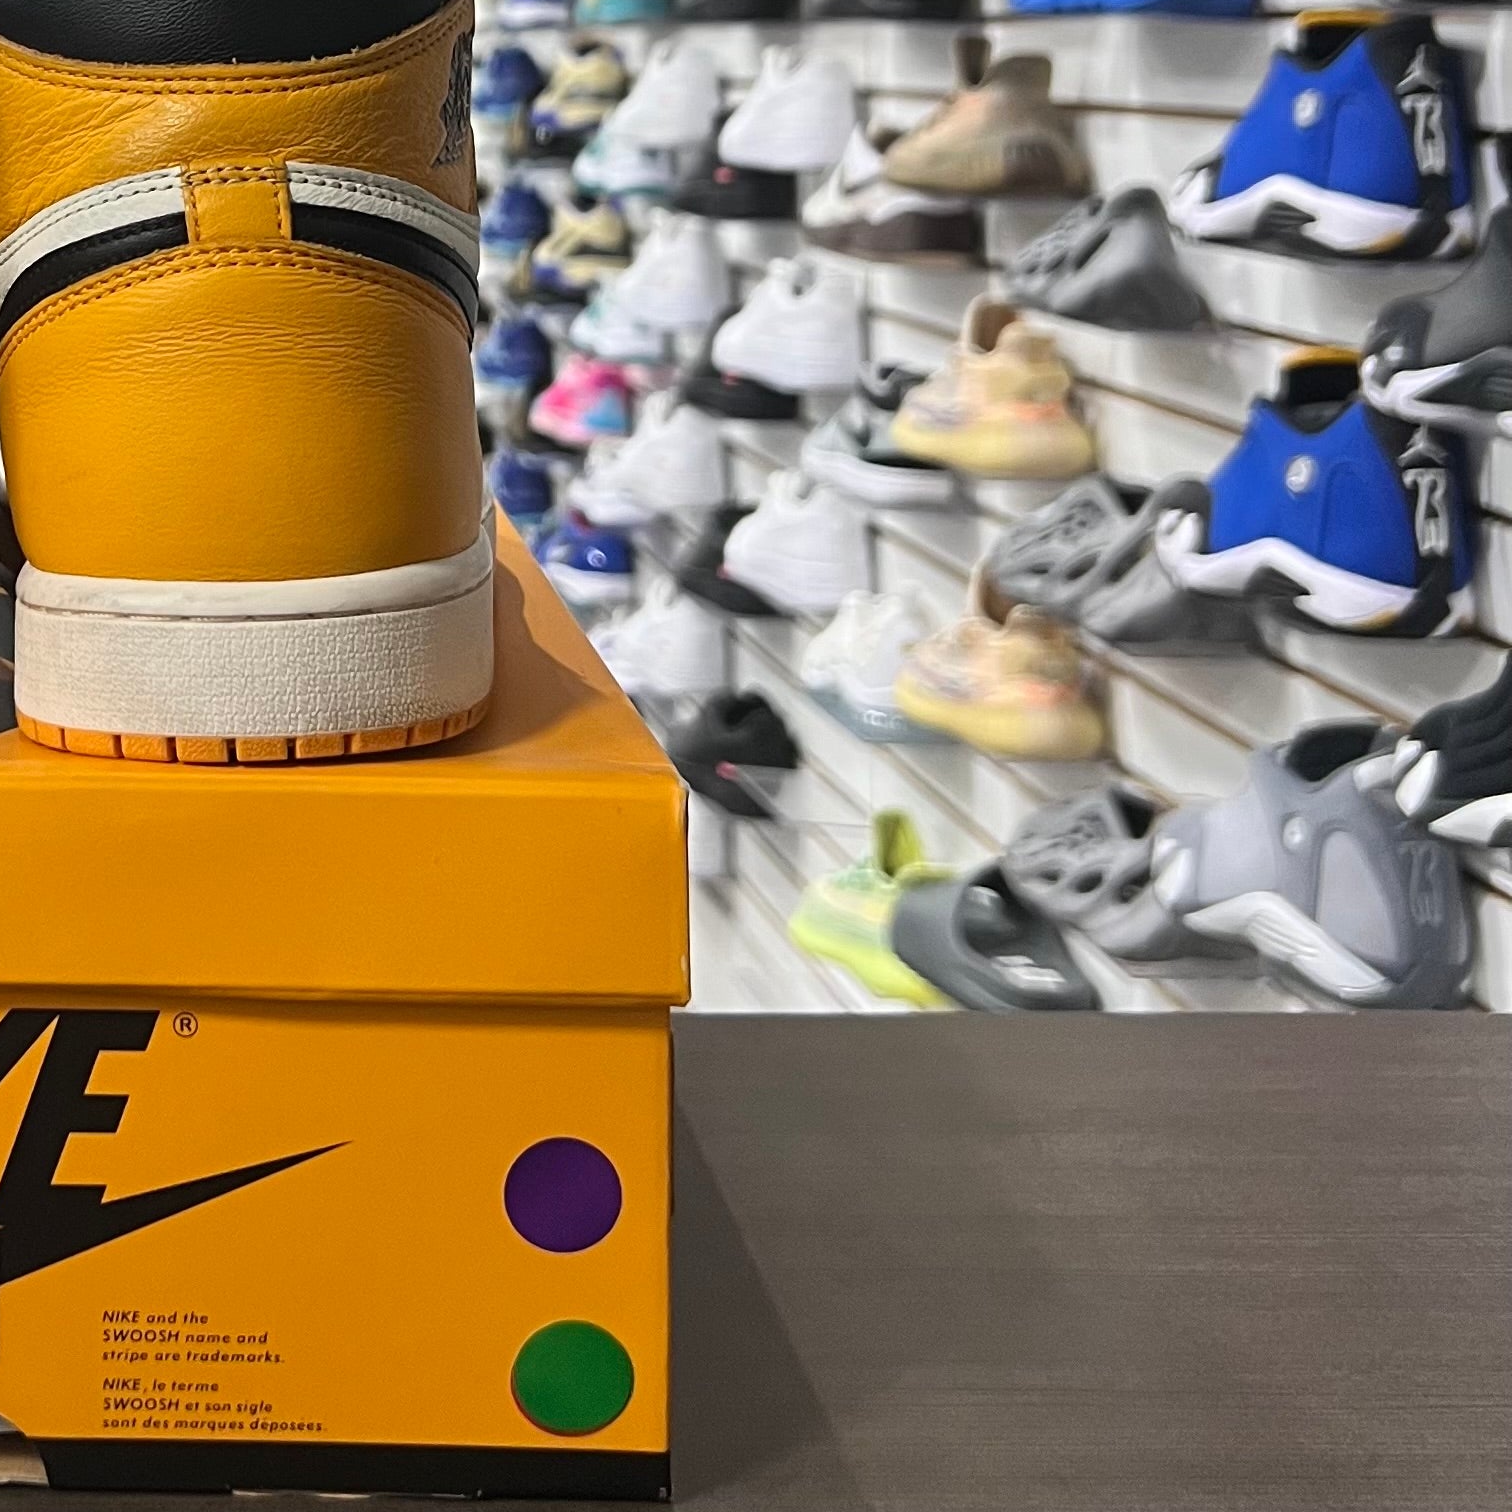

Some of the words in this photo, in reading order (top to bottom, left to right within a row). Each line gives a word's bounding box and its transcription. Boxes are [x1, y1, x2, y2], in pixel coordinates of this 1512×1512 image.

[102, 1310, 140, 1323] NIKE
[146, 1311, 177, 1324] and
[183, 1311, 209, 1324] the
[103, 1329, 180, 1343] SWOOSH
[185, 1333, 231, 1344] name
[236, 1331, 268, 1344] and
[102, 1348, 149, 1363] stripe
[154, 1352, 181, 1361] are
[152, 1378, 167, 1392] le
[171, 1380, 219, 1392] terme
[103, 1397, 180, 1411] SWOOSH
[185, 1401, 200, 1411] et
[205, 1402, 232, 1412] son
[236, 1399, 273, 1416] sigle
[103, 1417, 137, 1428] sont
[142, 1416, 169, 1428] des
[174, 1419, 245, 1432] marques
